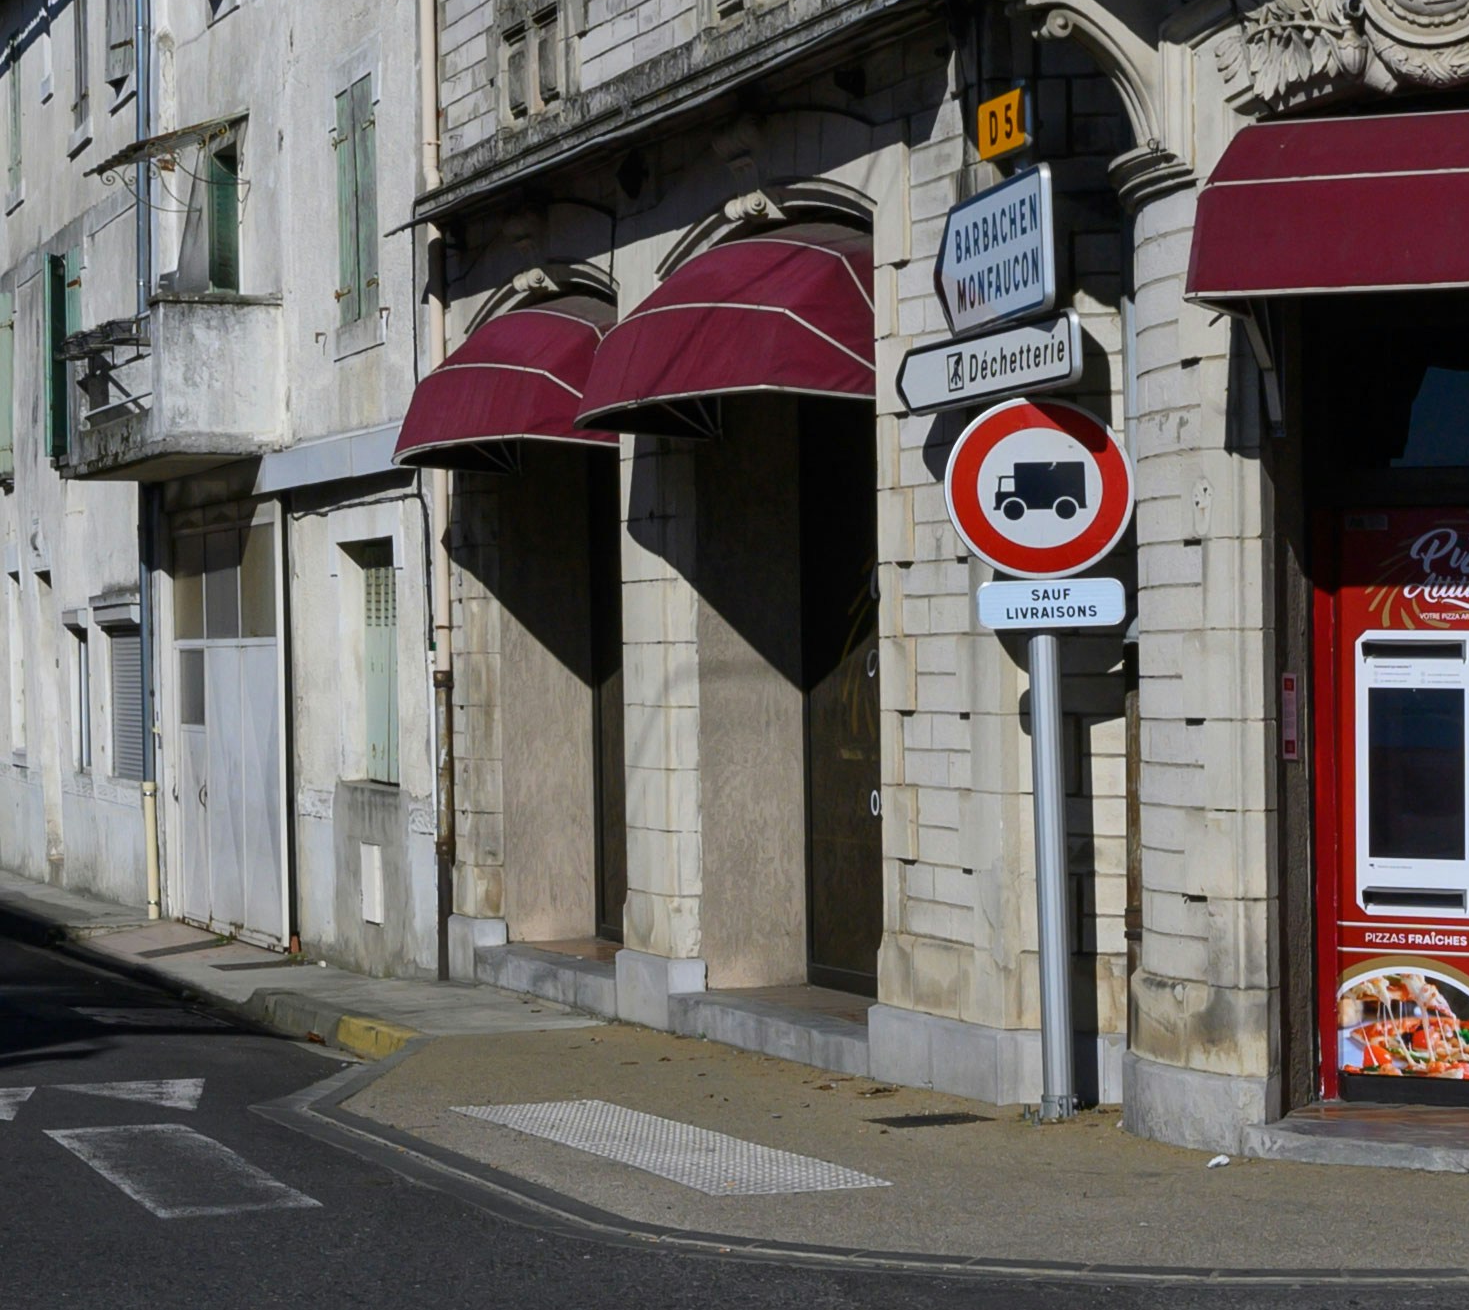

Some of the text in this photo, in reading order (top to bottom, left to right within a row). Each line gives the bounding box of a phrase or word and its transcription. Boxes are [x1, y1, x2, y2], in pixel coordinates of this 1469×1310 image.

[989, 103, 1014, 146] D 5
[955, 192, 1038, 264] BARBACHEN
[956, 246, 1040, 314] MONFAUCON
[968, 334, 1066, 382] Déchetterie
[1006, 604, 1098, 621] LIVRAISONS
[1031, 588, 1072, 602] SAUF
[1365, 932, 1406, 944] PIZZAS
[1408, 931, 1468, 946] FRAÎCHES
